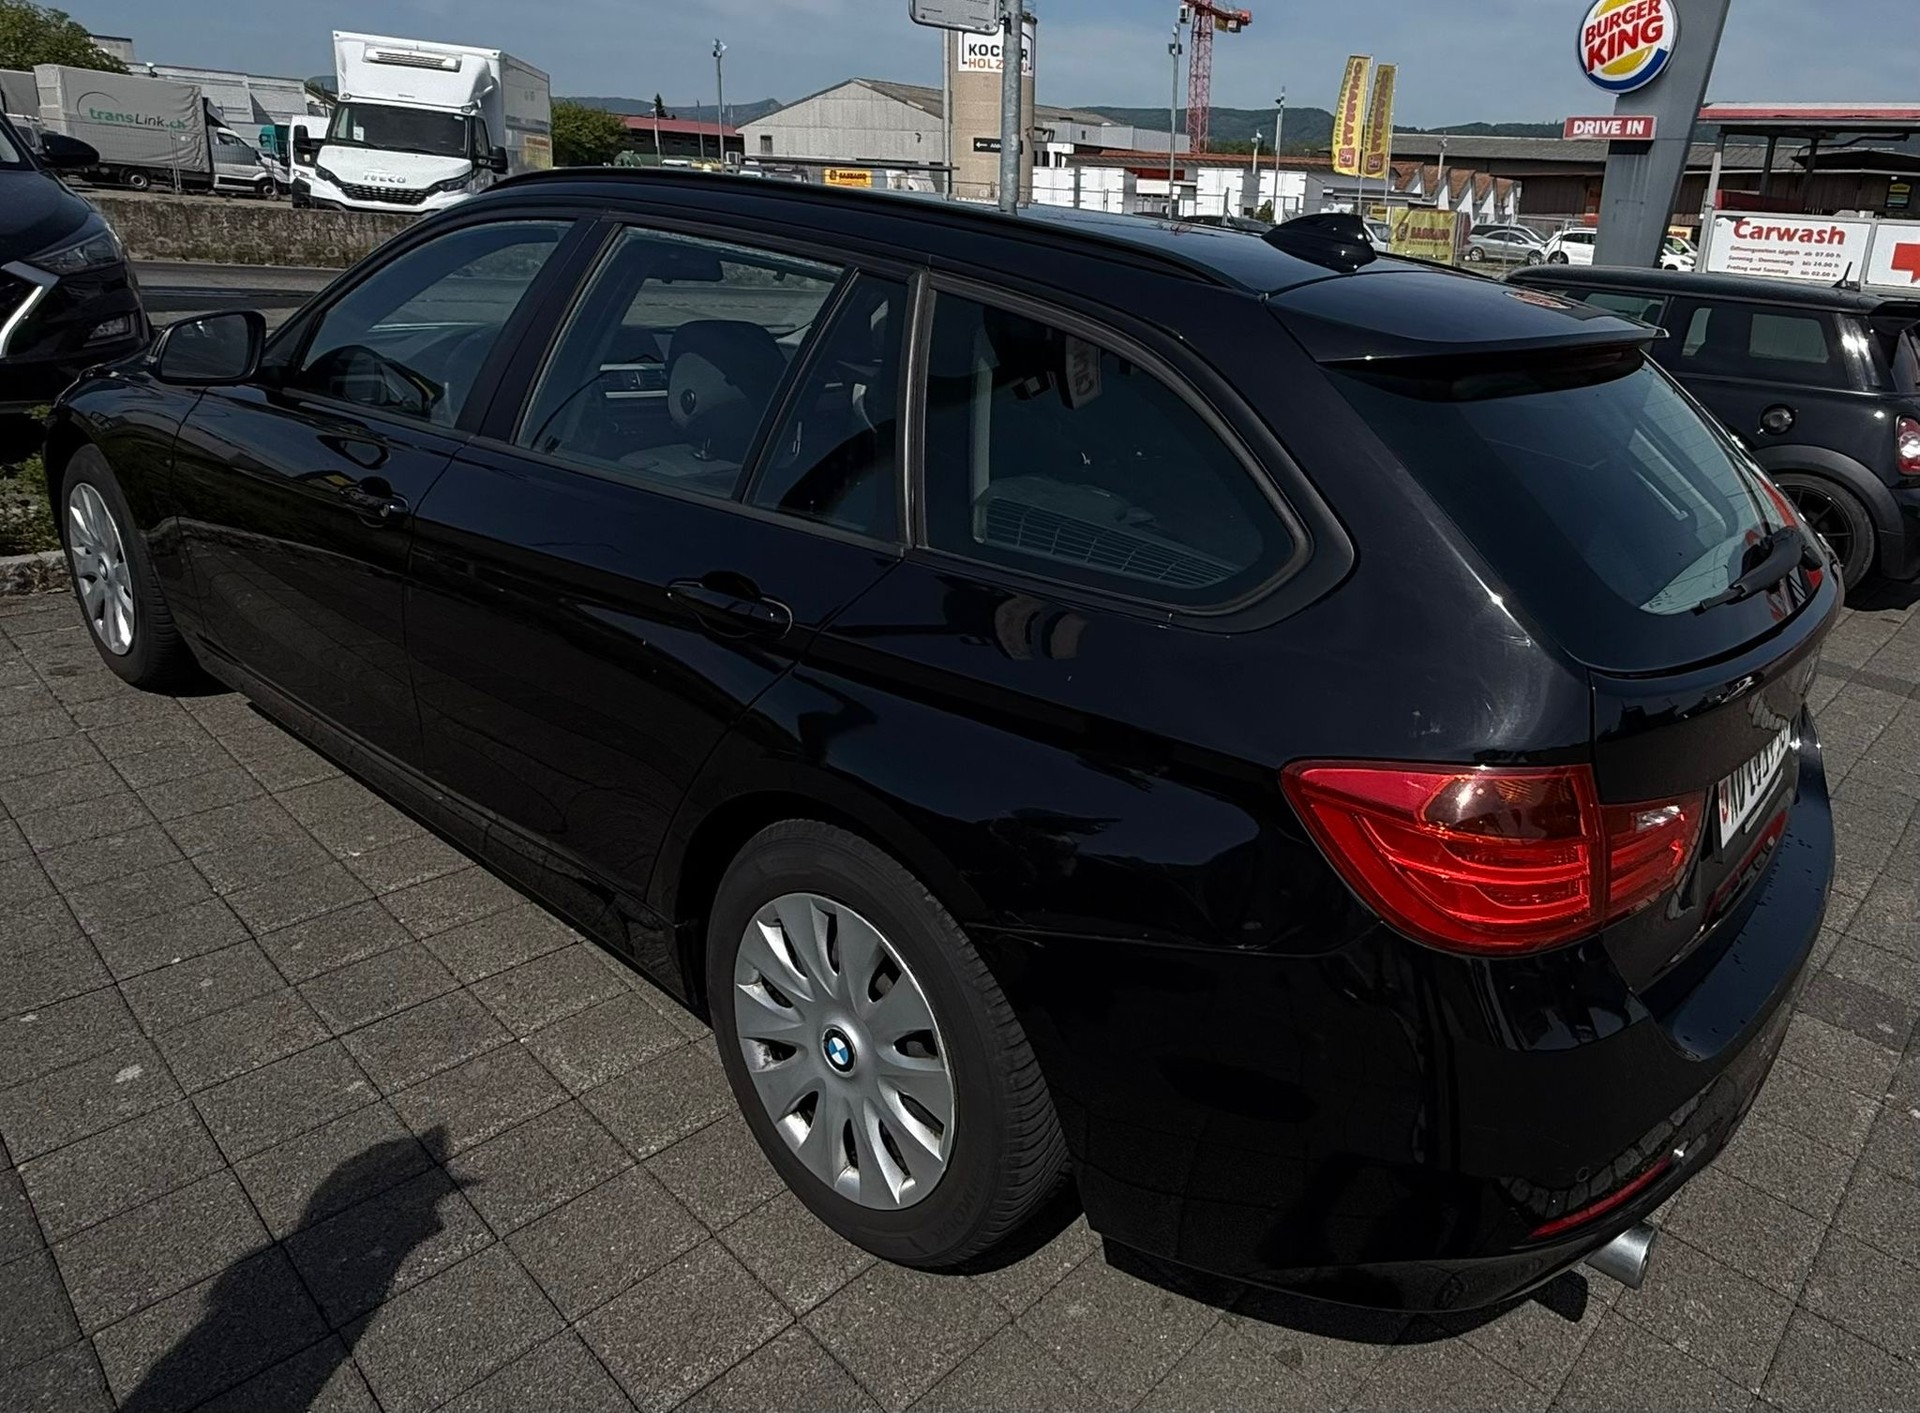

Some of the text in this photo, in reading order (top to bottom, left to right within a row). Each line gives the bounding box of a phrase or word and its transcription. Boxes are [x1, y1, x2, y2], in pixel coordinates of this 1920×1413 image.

[1585, 0, 1661, 47] BURGER
[968, 44, 1027, 61] KOCR
[1587, 15, 1664, 72] KING
[968, 58, 1027, 73] HOLZU
[89, 107, 187, 129] transLink.ch
[1573, 120, 1645, 135] DRIVE IN
[1733, 219, 1846, 245] Carwash
